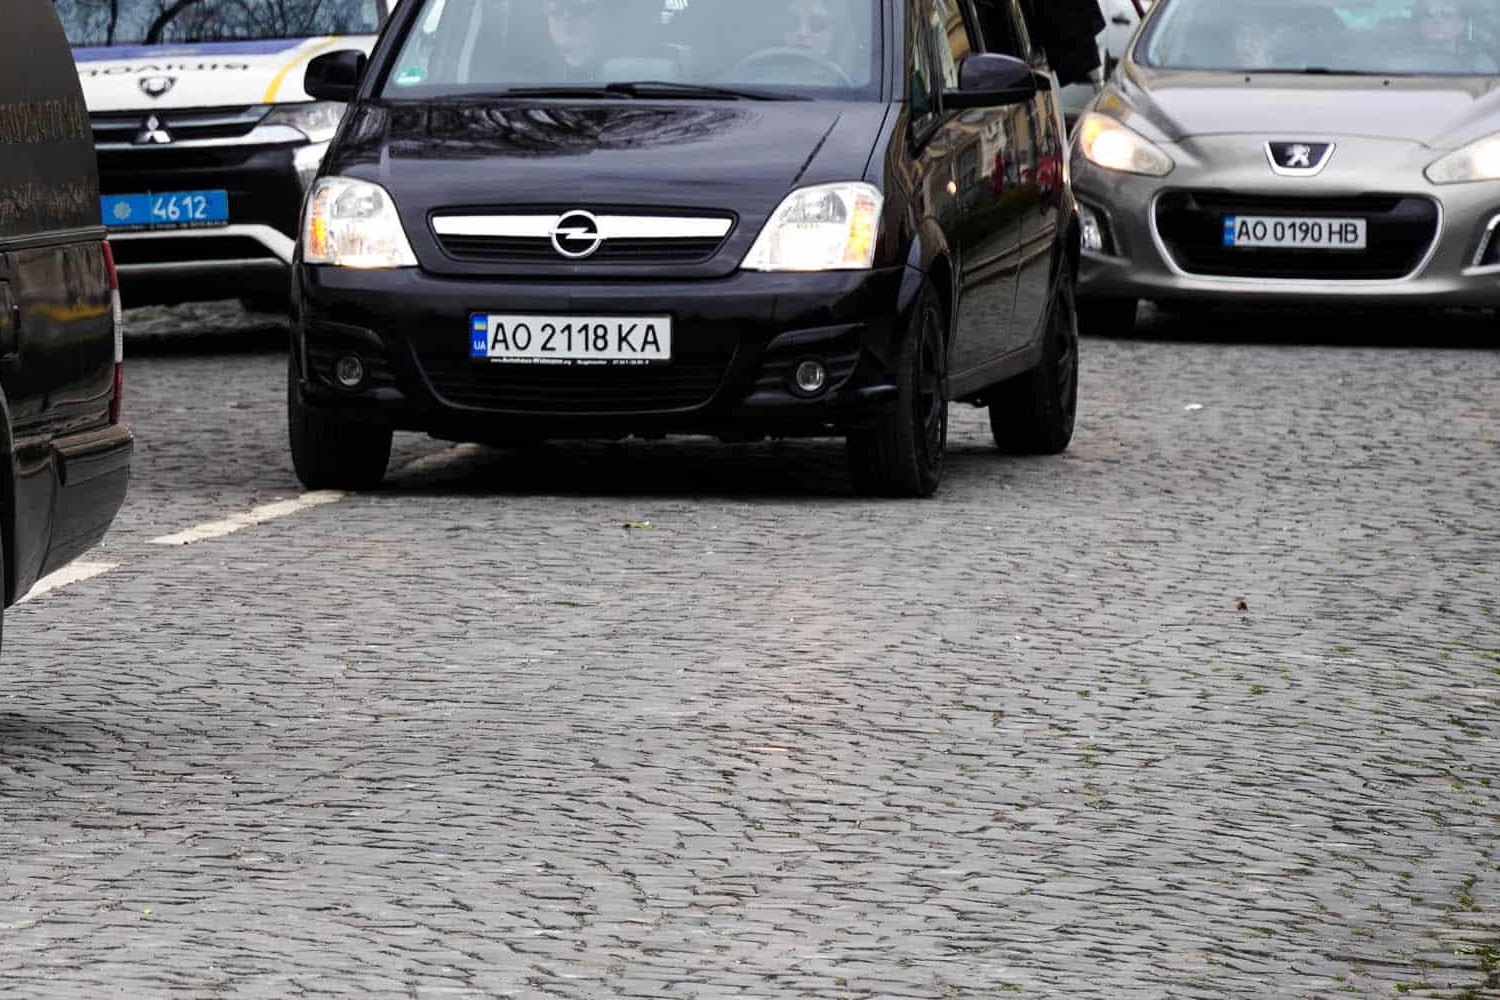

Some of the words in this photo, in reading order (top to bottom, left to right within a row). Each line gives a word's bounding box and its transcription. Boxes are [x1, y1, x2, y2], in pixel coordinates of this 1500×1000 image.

[153, 196, 206, 220] 4612
[1237, 221, 1267, 240] AO
[1274, 222, 1322, 242] 0190
[1328, 223, 1359, 243] HB
[491, 323, 531, 351] AO
[540, 323, 609, 352] 2118
[617, 324, 661, 353] KA
